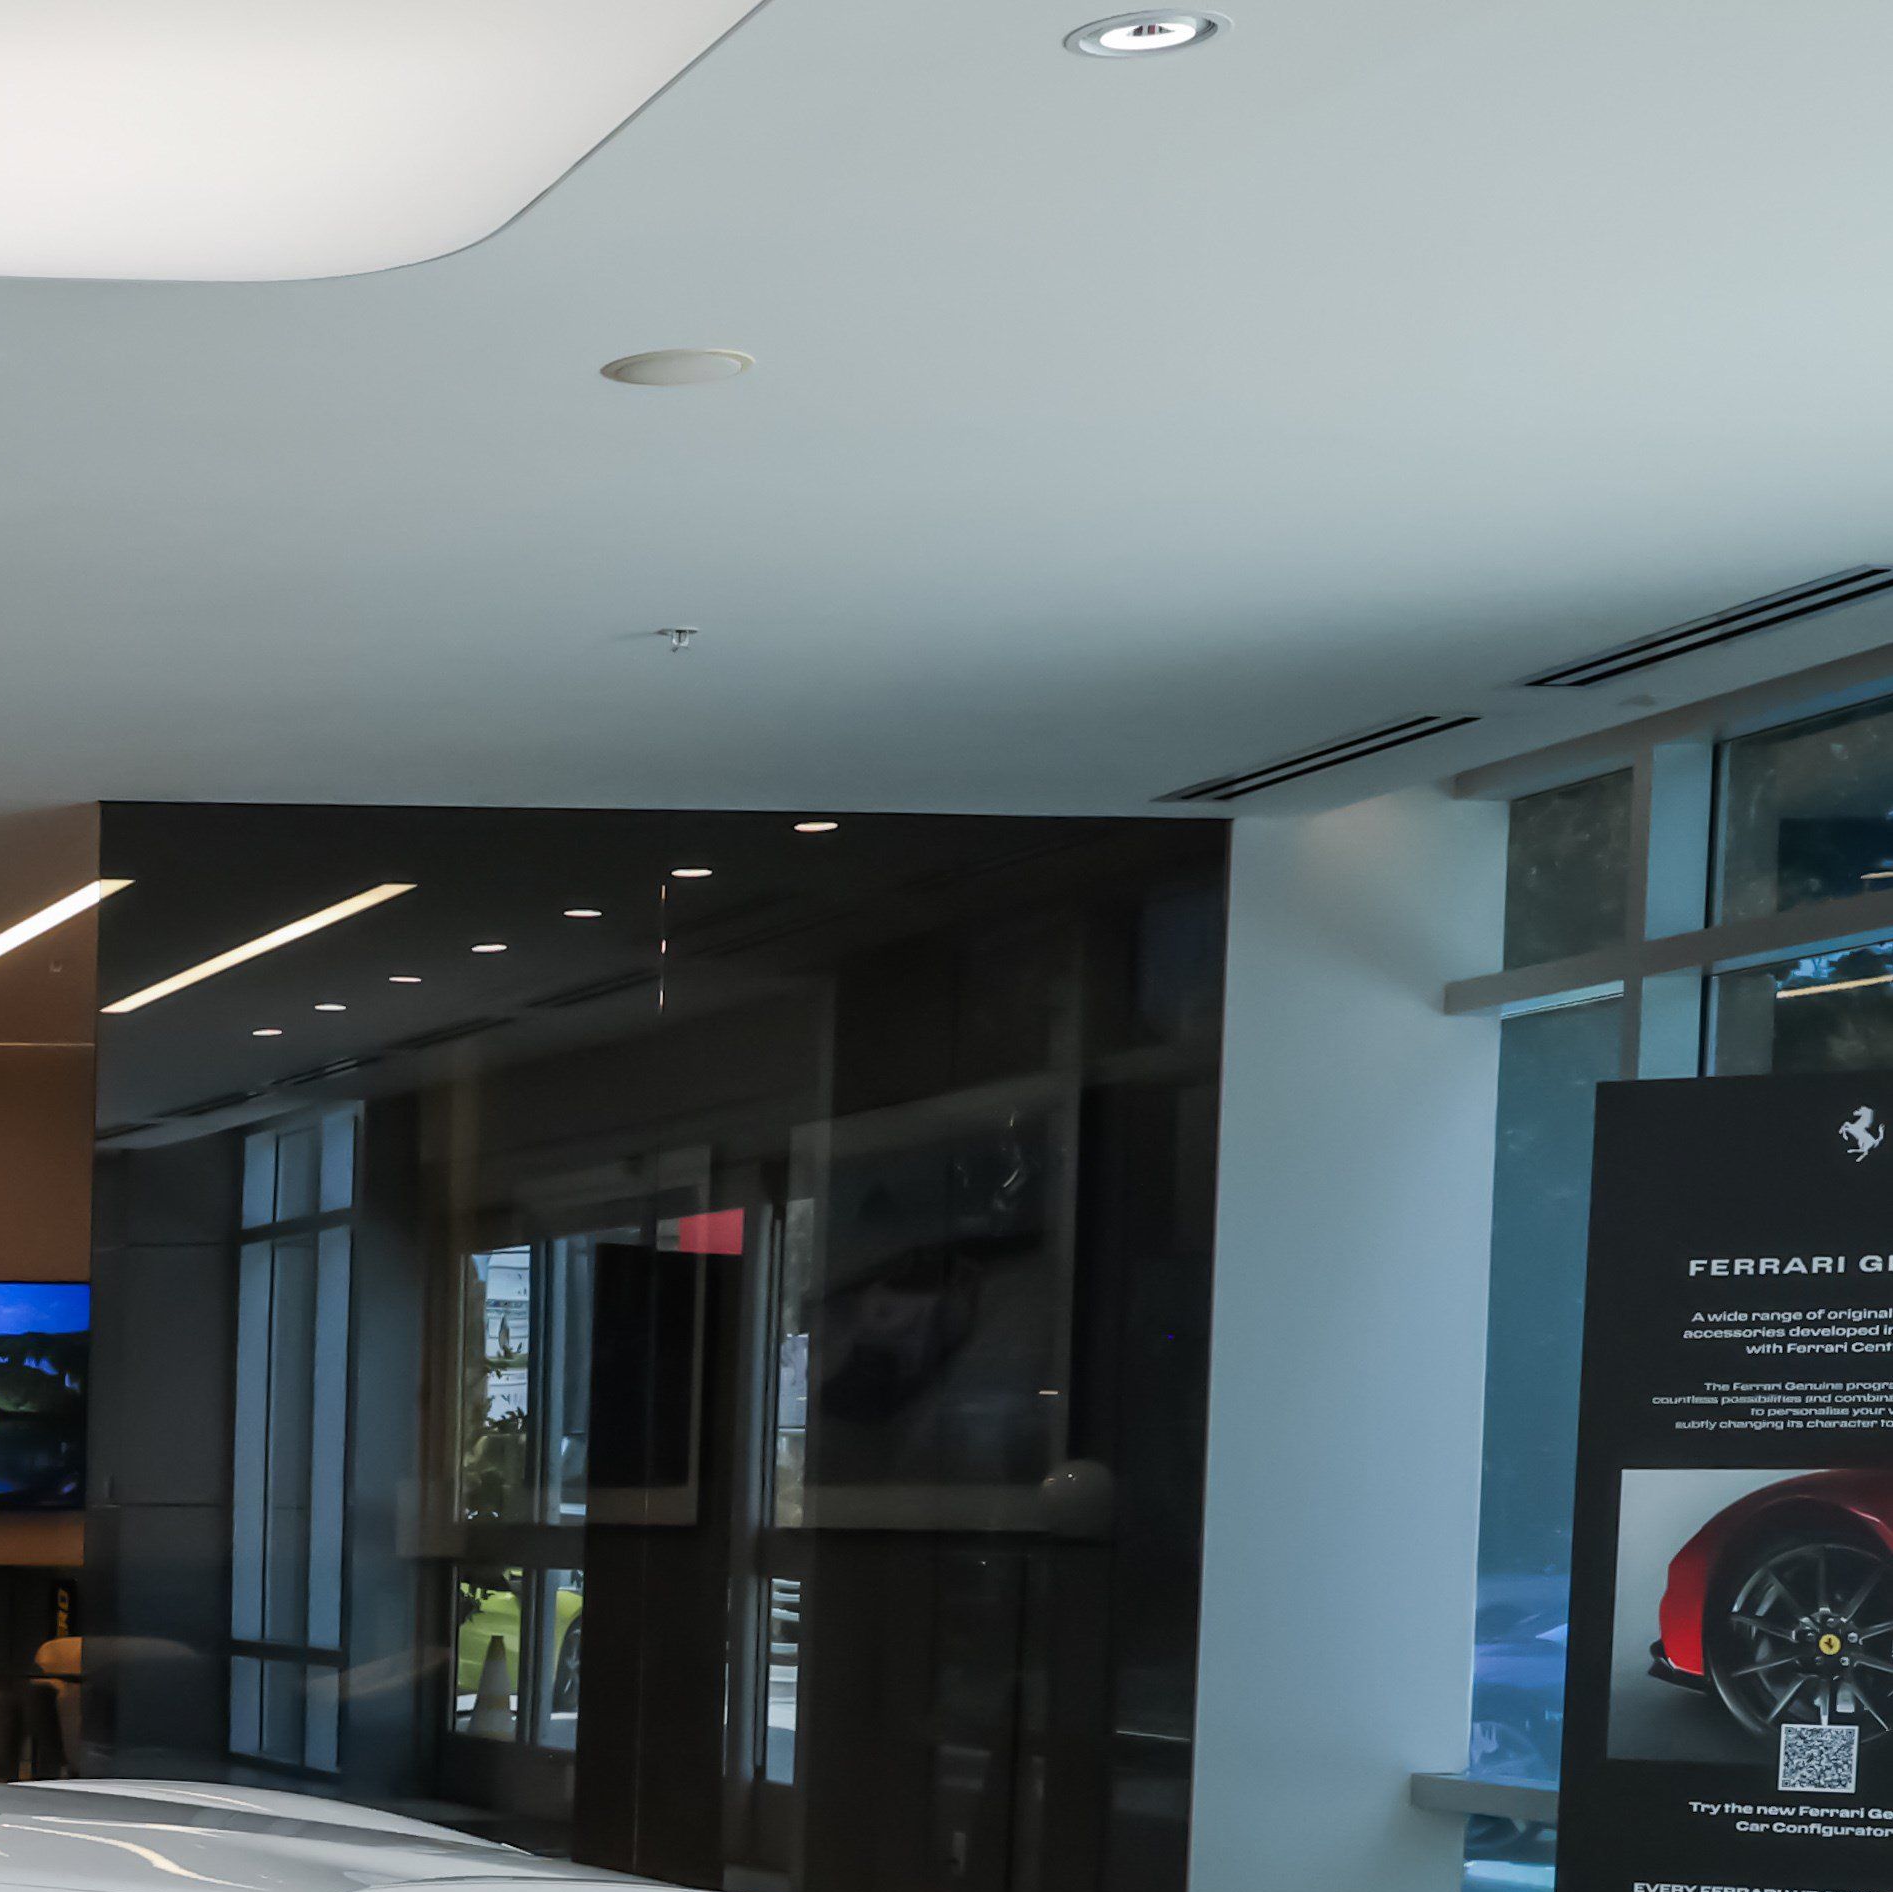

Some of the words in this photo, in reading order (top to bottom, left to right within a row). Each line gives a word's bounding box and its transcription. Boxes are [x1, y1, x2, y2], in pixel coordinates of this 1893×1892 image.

[1689, 1255, 1846, 1277] FERRARI
[1691, 1312, 1705, 1323] A
[1707, 1310, 1748, 1323] wide
[1751, 1311, 1803, 1324] range
[1806, 1308, 1824, 1321] of
[1827, 1307, 1893, 1322] original
[1683, 1326, 1785, 1340] accessories
[1788, 1324, 1880, 1338] developed
[1746, 1343, 1783, 1355] with
[1787, 1341, 1848, 1354] Ferrari
[1704, 1382, 1730, 1392] The
[1733, 1382, 1782, 1392] Ferrari
[1784, 1381, 1844, 1391] Genuine
[1652, 1395, 1719, 1405] countless
[1805, 1394, 1832, 1404] and
[1750, 1407, 1765, 1416] to
[1767, 1406, 1850, 1417] personalise
[1852, 1407, 1886, 1417] your
[1675, 1420, 1717, 1431] subtly
[1719, 1420, 1784, 1431] changing
[1787, 1419, 1804, 1429] its
[1807, 1418, 1878, 1429] character
[1689, 1801, 1722, 1815] Try
[1724, 1803, 1753, 1815] the
[1756, 1805, 1796, 1817] new
[1798, 1806, 1865, 1819] Ferrari
[1735, 1820, 1771, 1833] Car
[1772, 1821, 1893, 1838] Configurator
